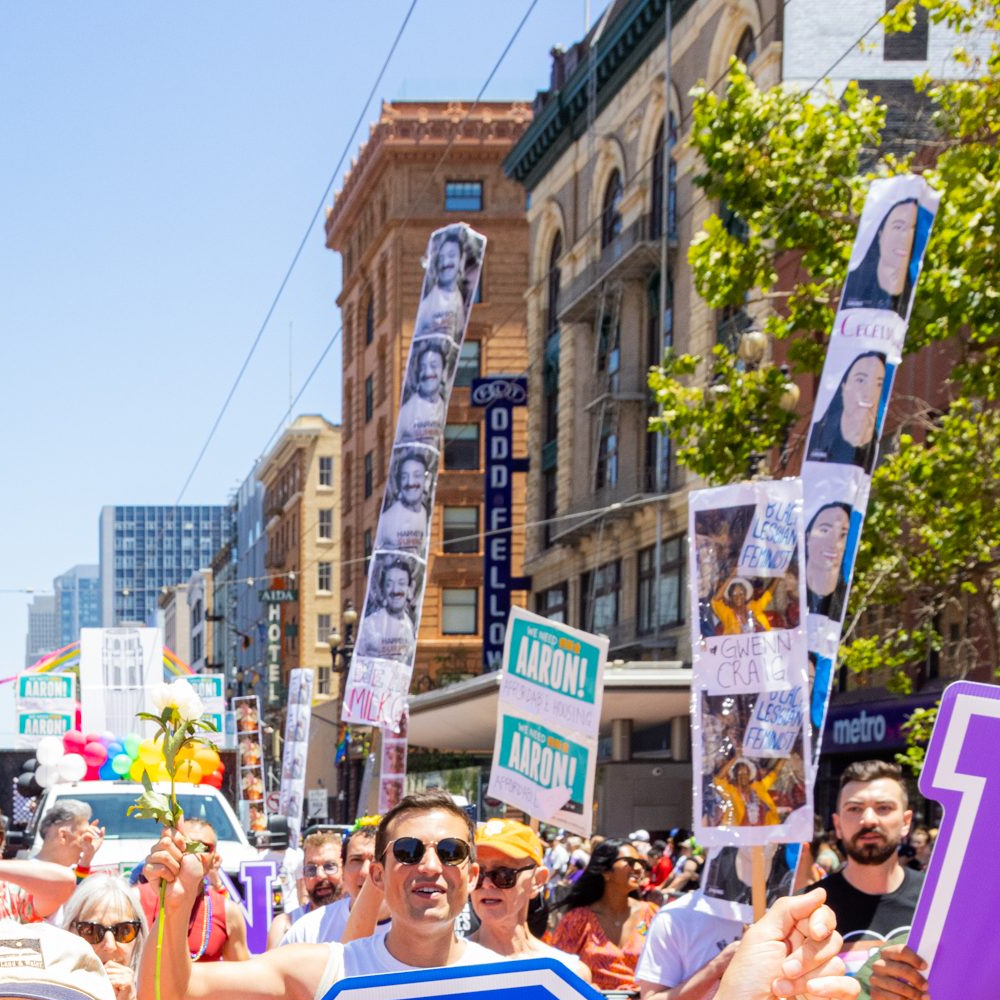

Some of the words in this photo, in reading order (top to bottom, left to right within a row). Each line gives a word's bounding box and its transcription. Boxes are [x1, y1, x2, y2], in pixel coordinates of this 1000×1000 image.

[490, 407, 508, 488] ODD
[261, 590, 294, 600] AIDA
[526, 626, 540, 639] WE
[538, 631, 558, 648] NEED
[720, 633, 792, 659] GWENN
[268, 603, 281, 700] HOTEL
[515, 635, 588, 698] AARON!
[25, 680, 68, 698] AARON!
[518, 722, 530, 735] WE
[529, 726, 546, 744] NEED
[833, 710, 886, 745] metro
